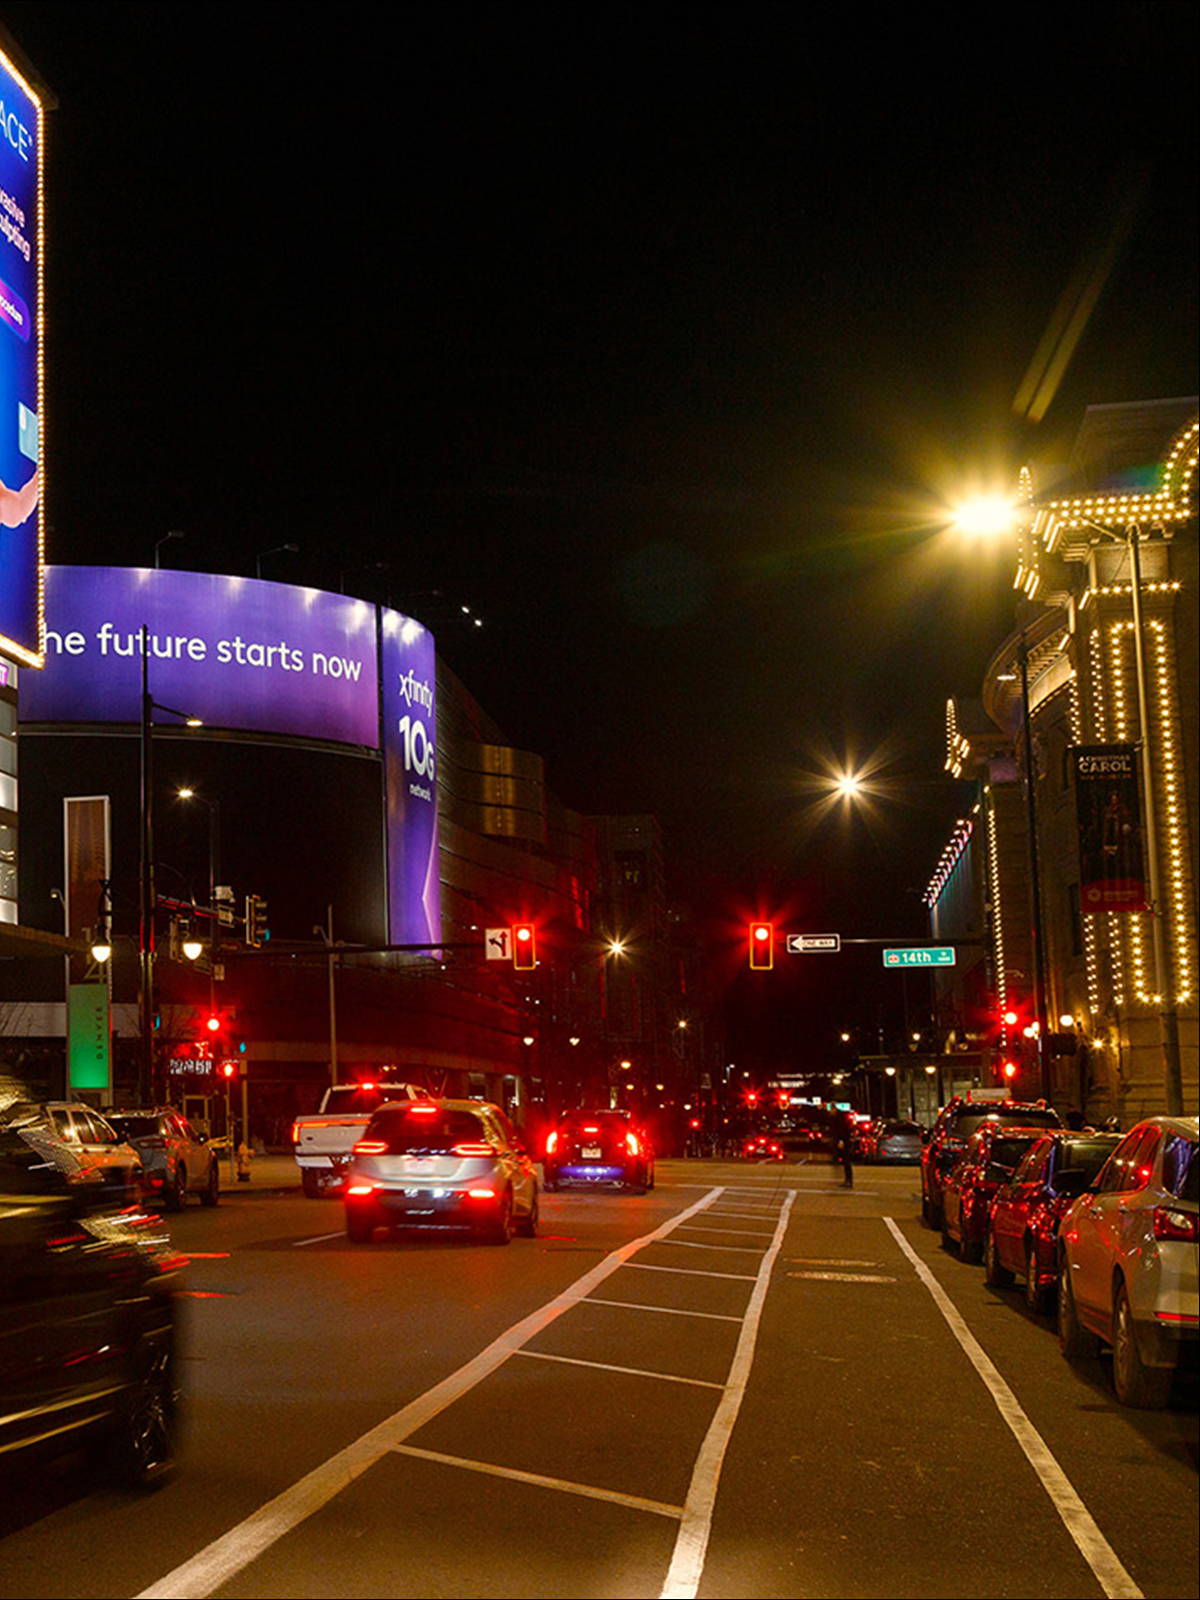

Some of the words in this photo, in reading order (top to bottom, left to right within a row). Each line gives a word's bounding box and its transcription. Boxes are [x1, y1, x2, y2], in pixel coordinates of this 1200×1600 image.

[45, 622, 85, 655] he
[97, 622, 206, 660] future
[216, 636, 304, 671] starts
[312, 652, 362, 682] now
[399, 669, 433, 717] xfinity
[1078, 761, 1131, 774] CAROL
[902, 952, 931, 963] 14th
